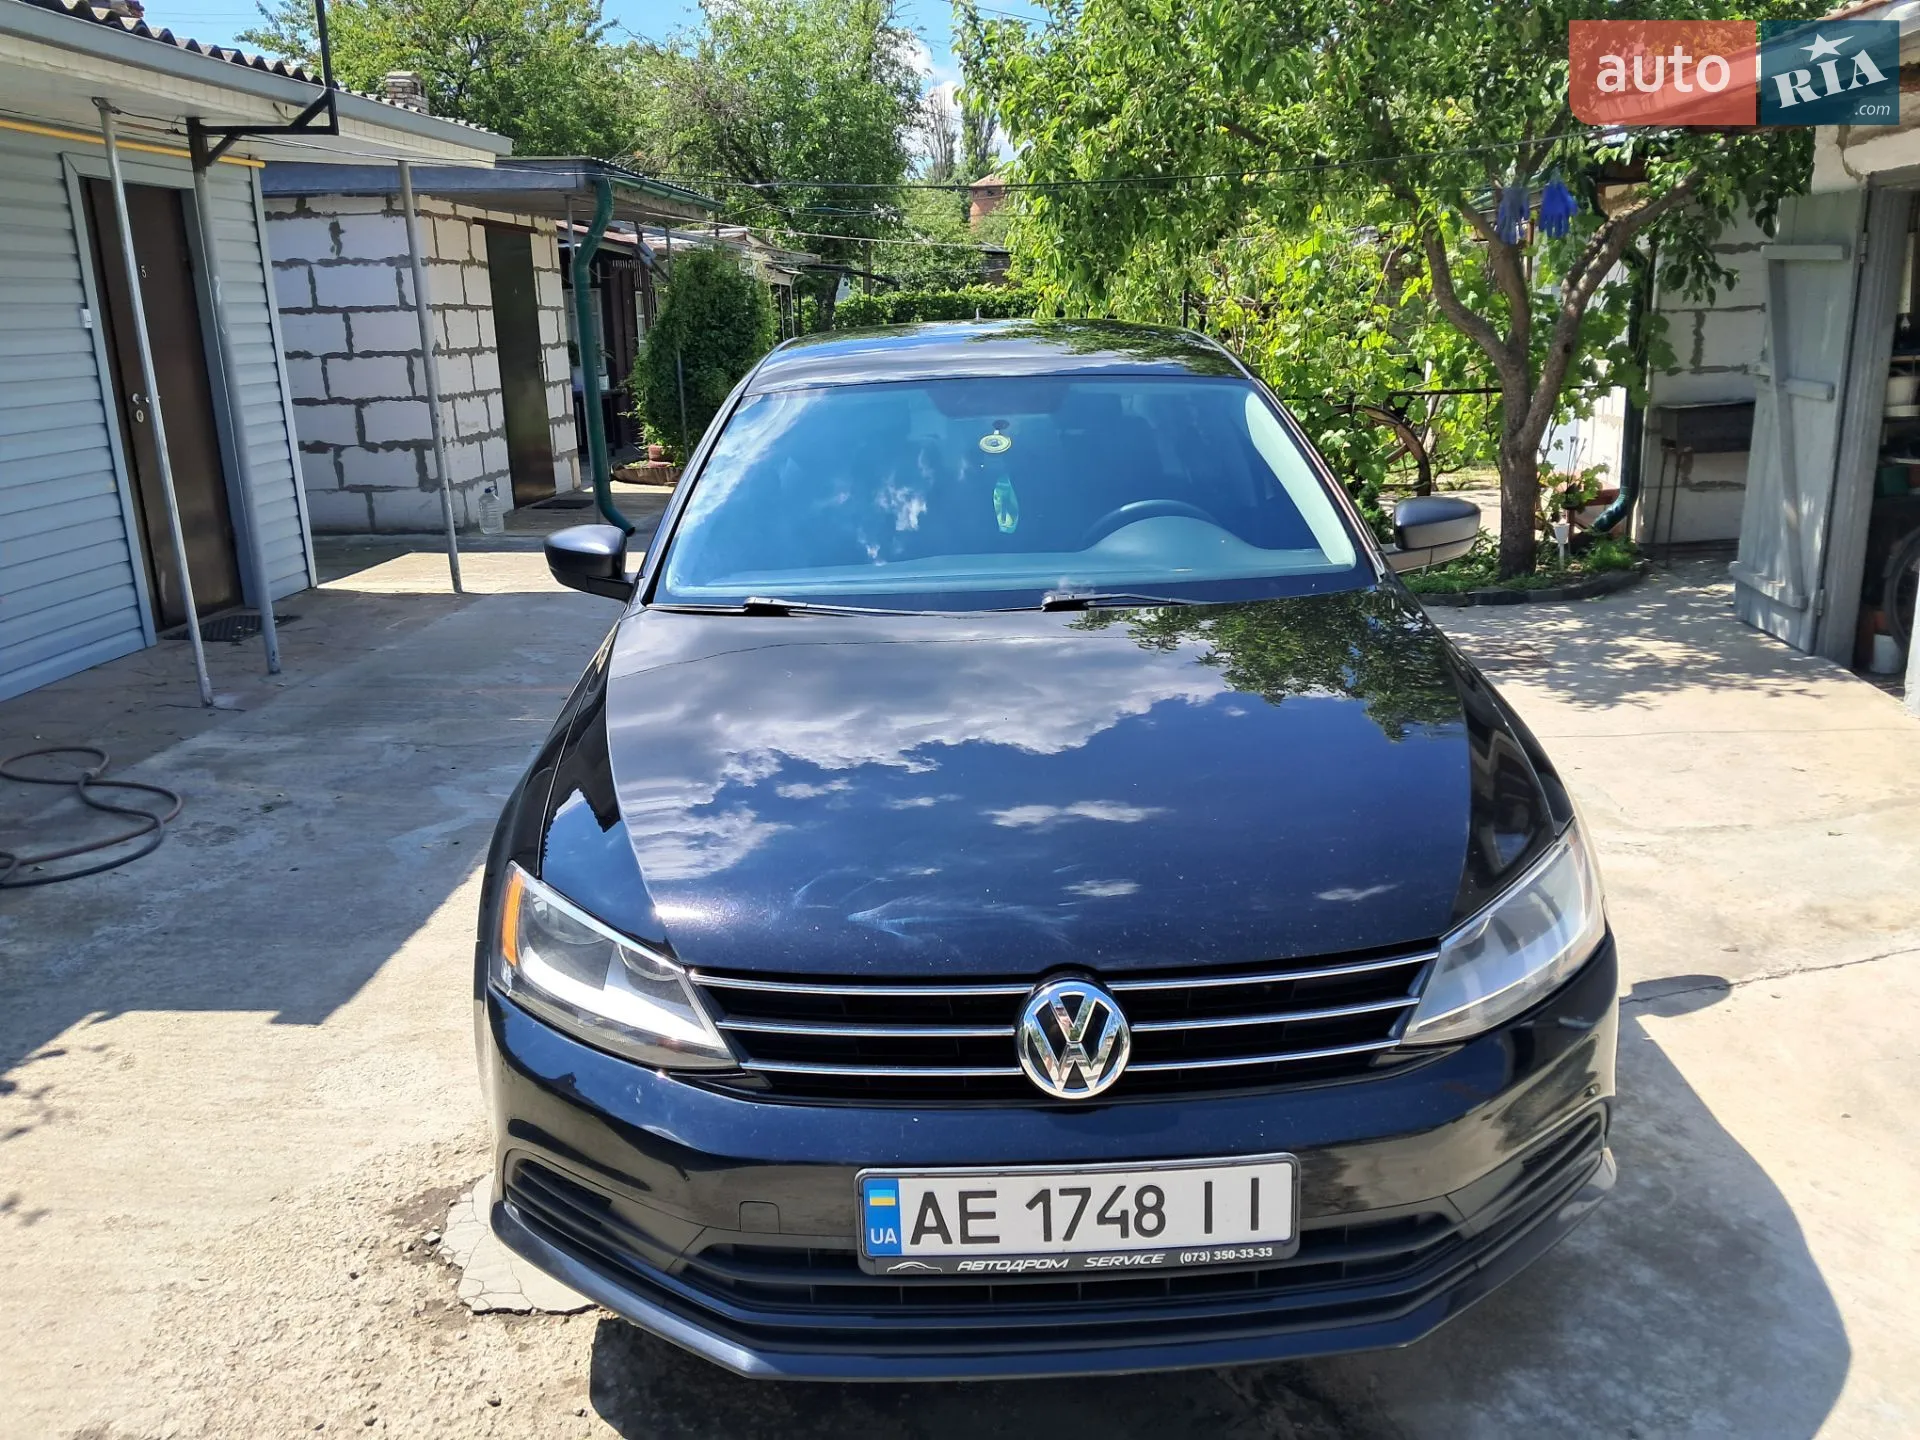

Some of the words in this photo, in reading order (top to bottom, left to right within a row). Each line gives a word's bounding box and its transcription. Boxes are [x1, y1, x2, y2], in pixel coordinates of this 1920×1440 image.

[909, 1190, 1000, 1246] AE
[1025, 1184, 1167, 1242] 1748
[870, 1227, 898, 1245] UA
[956, 1258, 1070, 1273] АВТОДРОМ
[1083, 1253, 1166, 1268] SERVICE
[1179, 1251, 1211, 1264] (073)
[1213, 1246, 1274, 1261] 350-33-33
